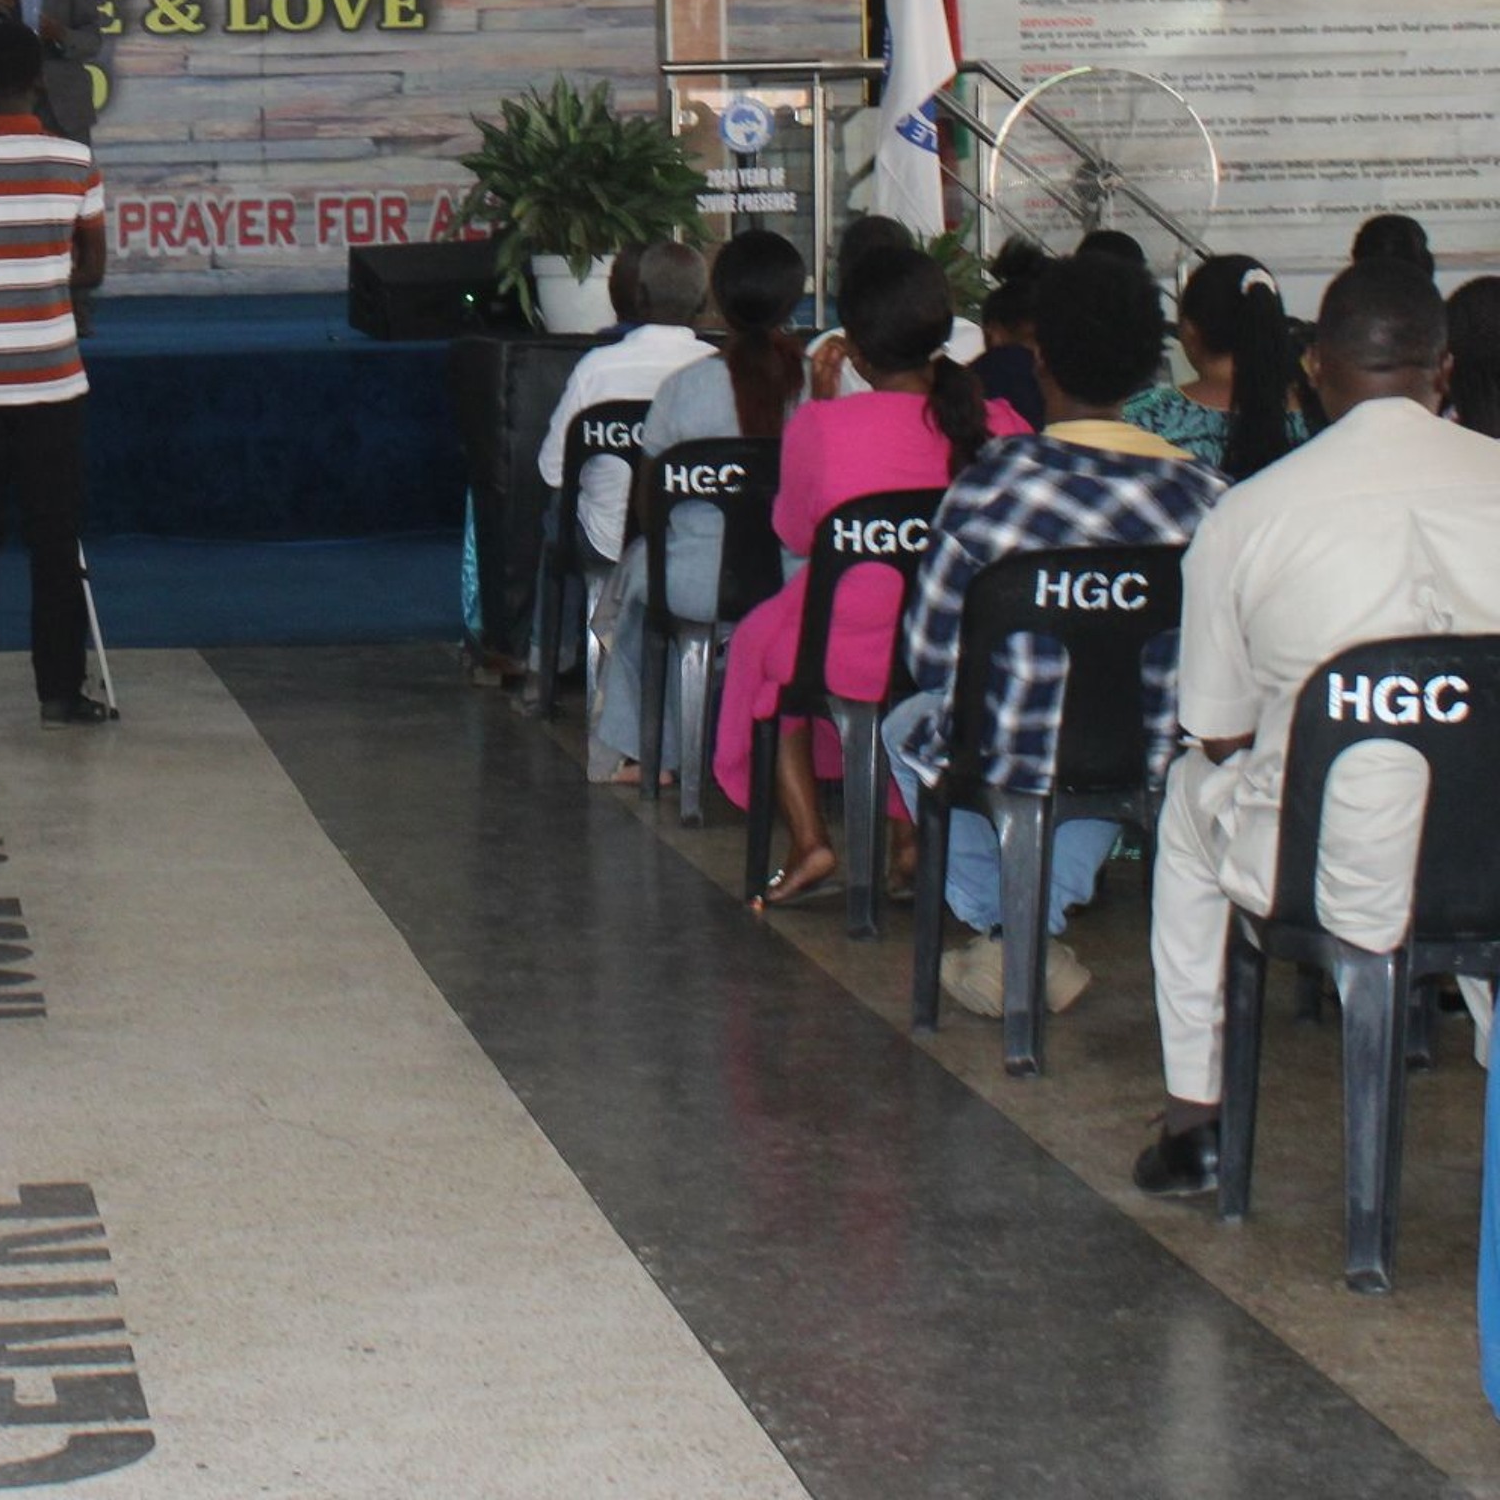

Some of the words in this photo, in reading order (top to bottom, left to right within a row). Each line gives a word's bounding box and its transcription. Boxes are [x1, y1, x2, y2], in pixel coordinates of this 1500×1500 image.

[118, 200, 296, 247] PRAYER
[318, 197, 409, 244] FOR
[664, 463, 747, 494] HGC
[833, 517, 929, 555] HGC
[1034, 568, 1149, 611] HGC
[1327, 672, 1470, 725] HGC
